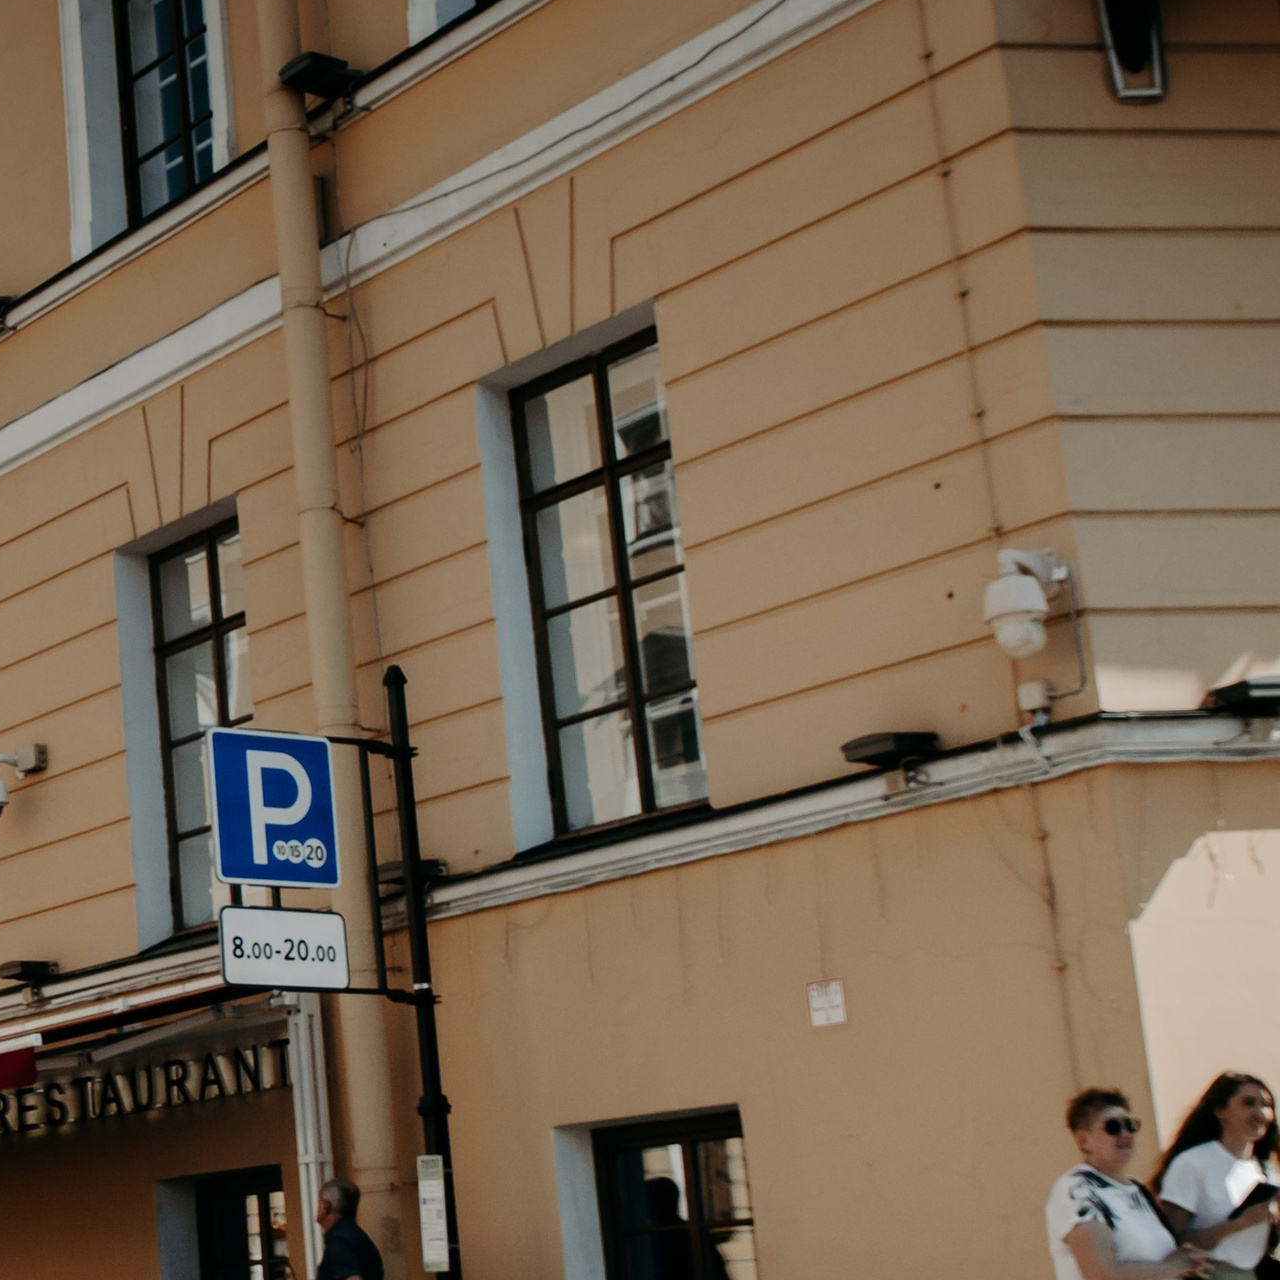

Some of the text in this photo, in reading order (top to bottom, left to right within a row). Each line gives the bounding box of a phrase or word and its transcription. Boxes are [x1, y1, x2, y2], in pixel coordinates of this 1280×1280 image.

[246, 749, 313, 865] P
[289, 844, 301, 858] 15
[306, 844, 324, 861] 20
[232, 937, 336, 963] 8.00-20.00
